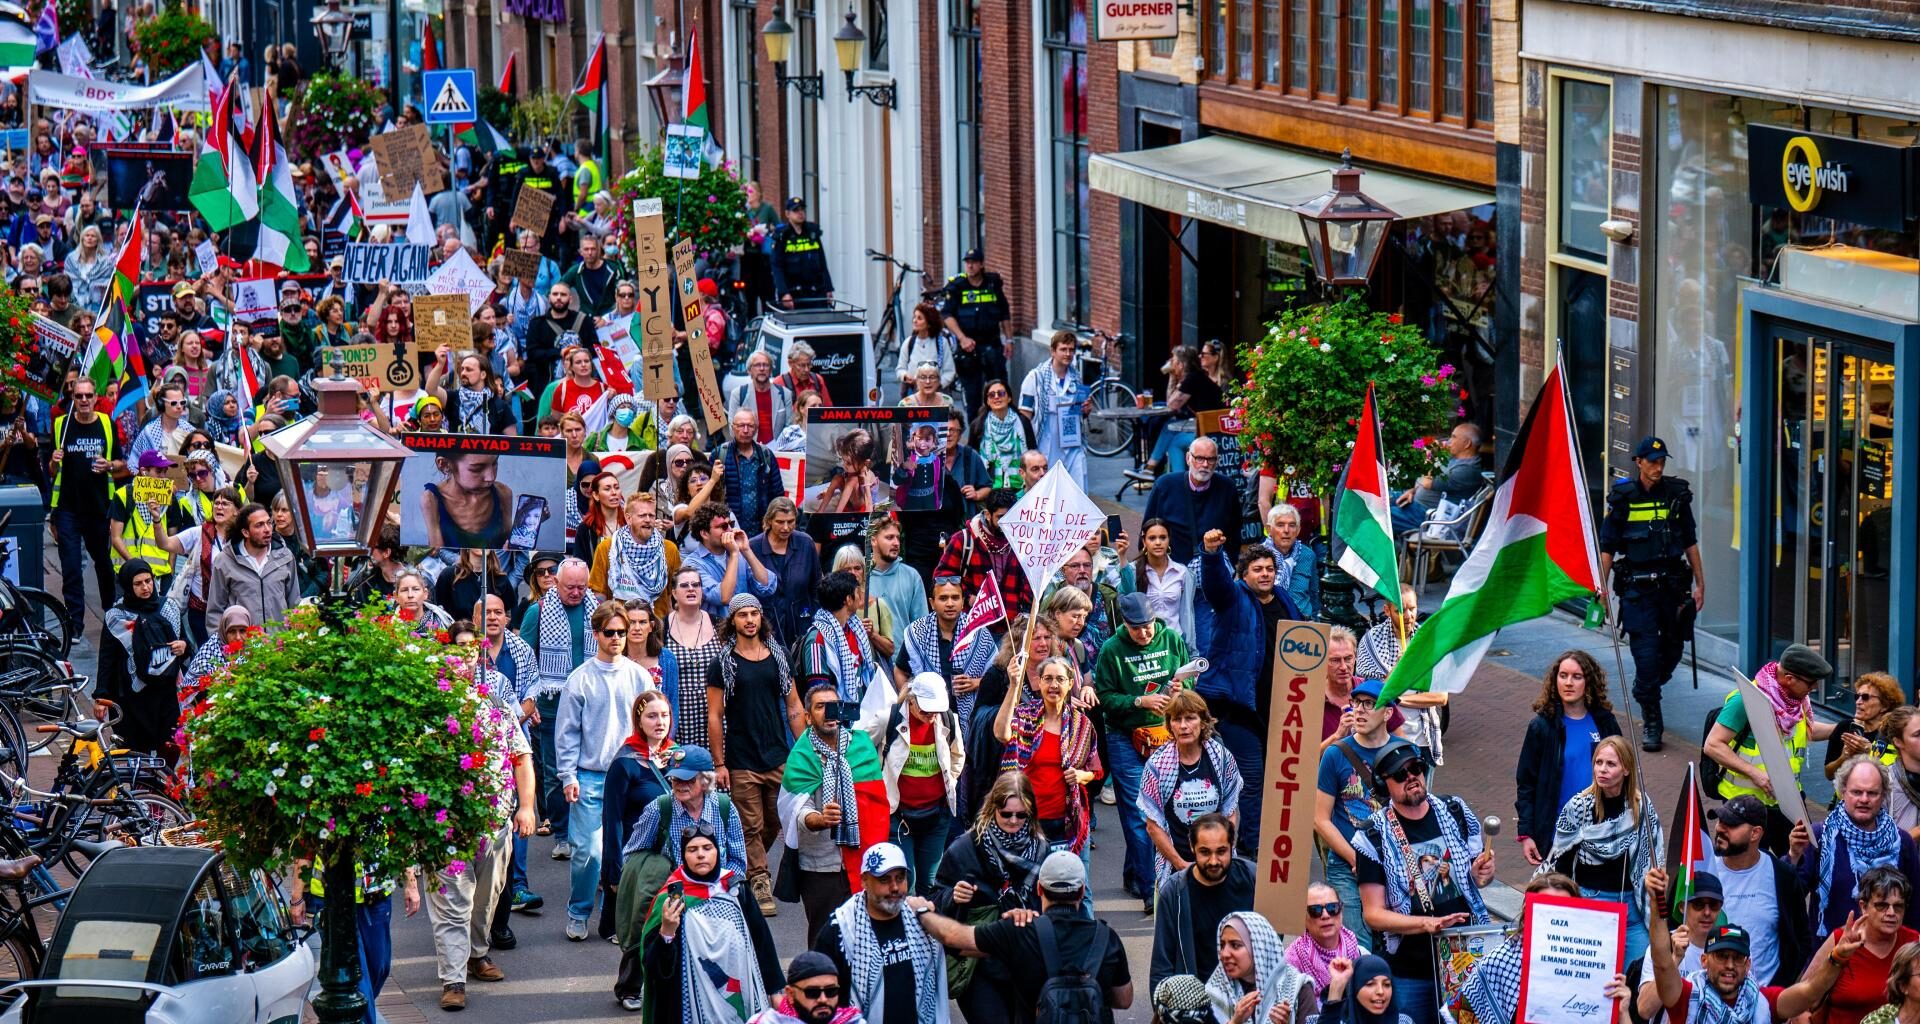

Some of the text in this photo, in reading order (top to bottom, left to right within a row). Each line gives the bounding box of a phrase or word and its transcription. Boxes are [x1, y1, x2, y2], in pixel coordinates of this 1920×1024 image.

[1106, 3, 1173, 17] GULPENER
[86, 86, 115, 100] BDS
[343, 244, 429, 282] NEVER AGAIN
[345, 364, 371, 378] TEGE
[820, 410, 852, 420] JANA
[854, 410, 893, 420] AYYAD
[916, 410, 930, 419] YR
[404, 436, 553, 452] RAHAF AYYAD 12 YR
[136, 477, 152, 489] YOUR
[134, 491, 142, 501] IS
[1034, 496, 1065, 513] IF I
[1019, 509, 1089, 526] MUST DIE
[1010, 523, 1093, 541] YOU MUST LIVE
[1017, 541, 1080, 555] TO TELL MY
[1027, 553, 1067, 568] STORY
[1142, 650, 1169, 660] AGAINST
[1138, 660, 1161, 673] ALL
[1132, 670, 1170, 682] GENOCIDES
[1269, 677, 1309, 883] SANCTION
[1176, 799, 1218, 809] GENOCIDE
[1550, 918, 1569, 928] GAZA
[1547, 933, 1602, 947] VAN WEGKIJKEN
[1559, 946, 1574, 955] NOG
[1576, 948, 1598, 957] NOOIT
[889, 953, 898, 965] IN
[1540, 954, 1606, 970] IEMAND SCHERPER
[198, 961, 230, 973] CARVER
[1554, 968, 1591, 979] GAAN ZIEN
